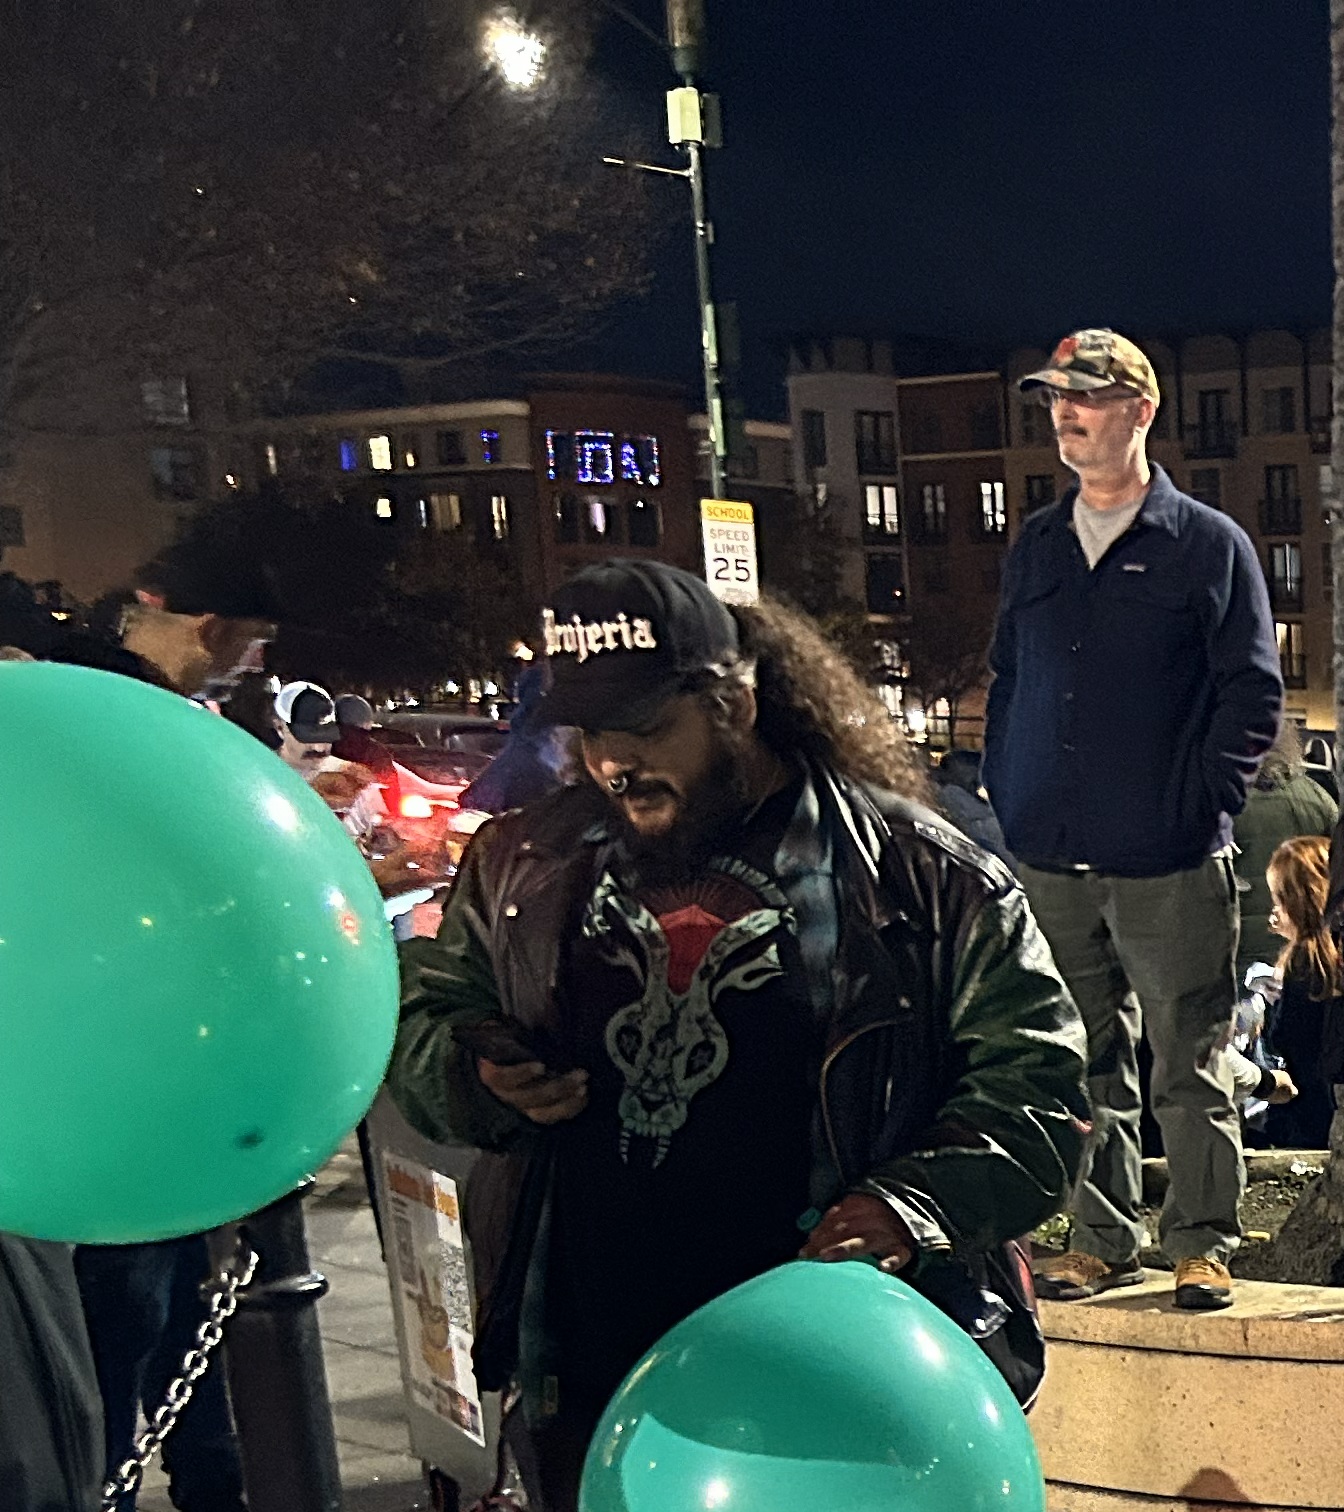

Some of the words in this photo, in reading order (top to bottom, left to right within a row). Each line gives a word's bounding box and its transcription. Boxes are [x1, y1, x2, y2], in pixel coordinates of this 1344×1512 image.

[706, 505, 749, 520] SCHOOL
[709, 527, 750, 542] SPEED
[713, 542, 748, 555] LIMIT
[713, 557, 750, 582] 25
